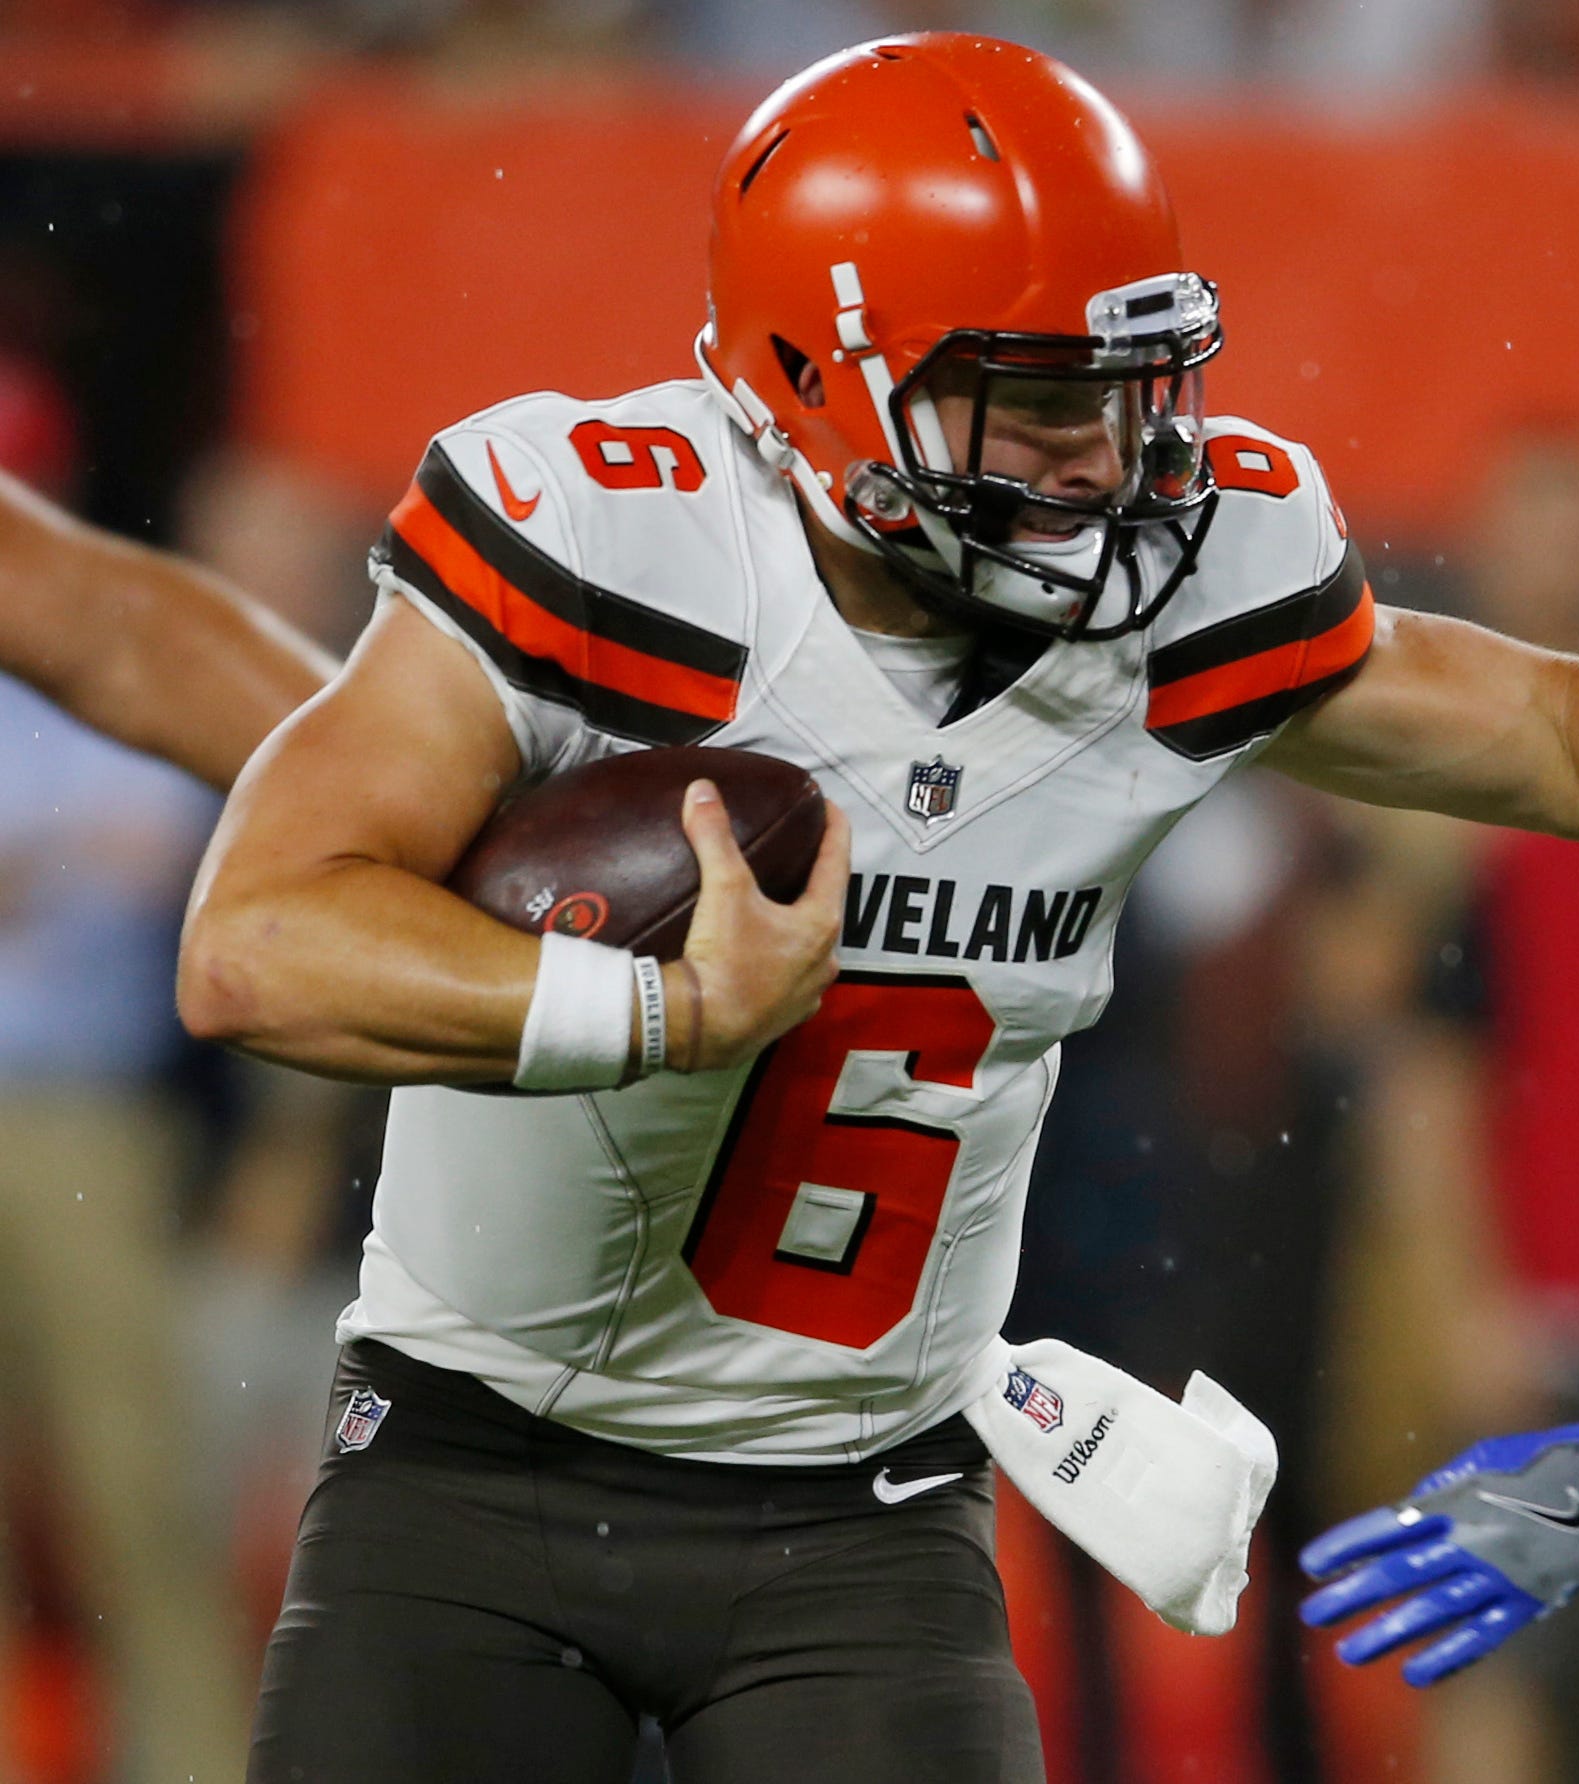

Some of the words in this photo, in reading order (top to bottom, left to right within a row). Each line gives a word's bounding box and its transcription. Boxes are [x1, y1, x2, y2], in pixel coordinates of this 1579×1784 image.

[841, 872, 1102, 963] VELAND
[680, 968, 998, 1352] 6
[1023, 1387, 1059, 1430] NFL
[1052, 1414, 1115, 1484] Wilson
